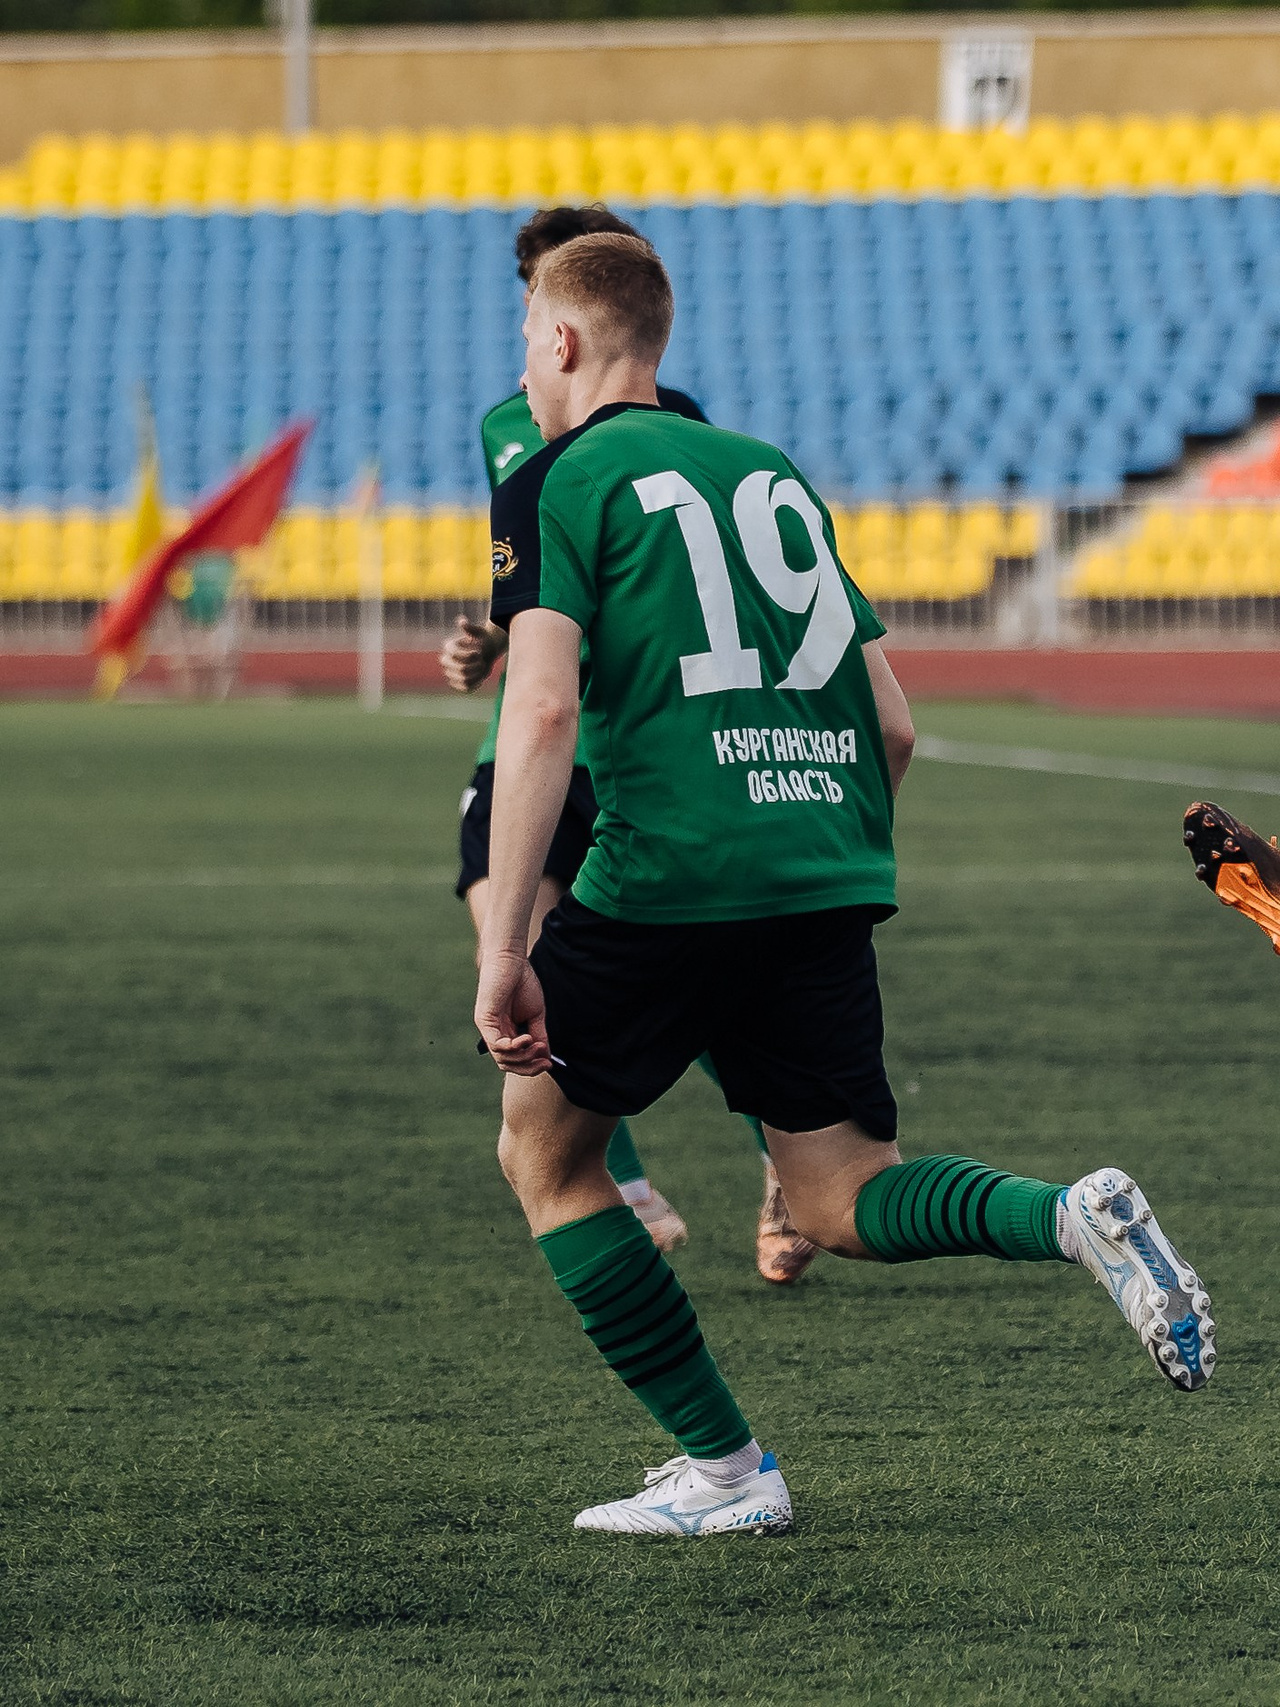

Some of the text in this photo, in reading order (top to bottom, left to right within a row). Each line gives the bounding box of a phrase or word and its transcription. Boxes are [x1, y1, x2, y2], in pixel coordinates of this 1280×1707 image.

[632, 470, 856, 696] 19
[712, 728, 857, 765] КУРГАНСКАЯ
[747, 769, 844, 804] ОБЛАСТЬ
